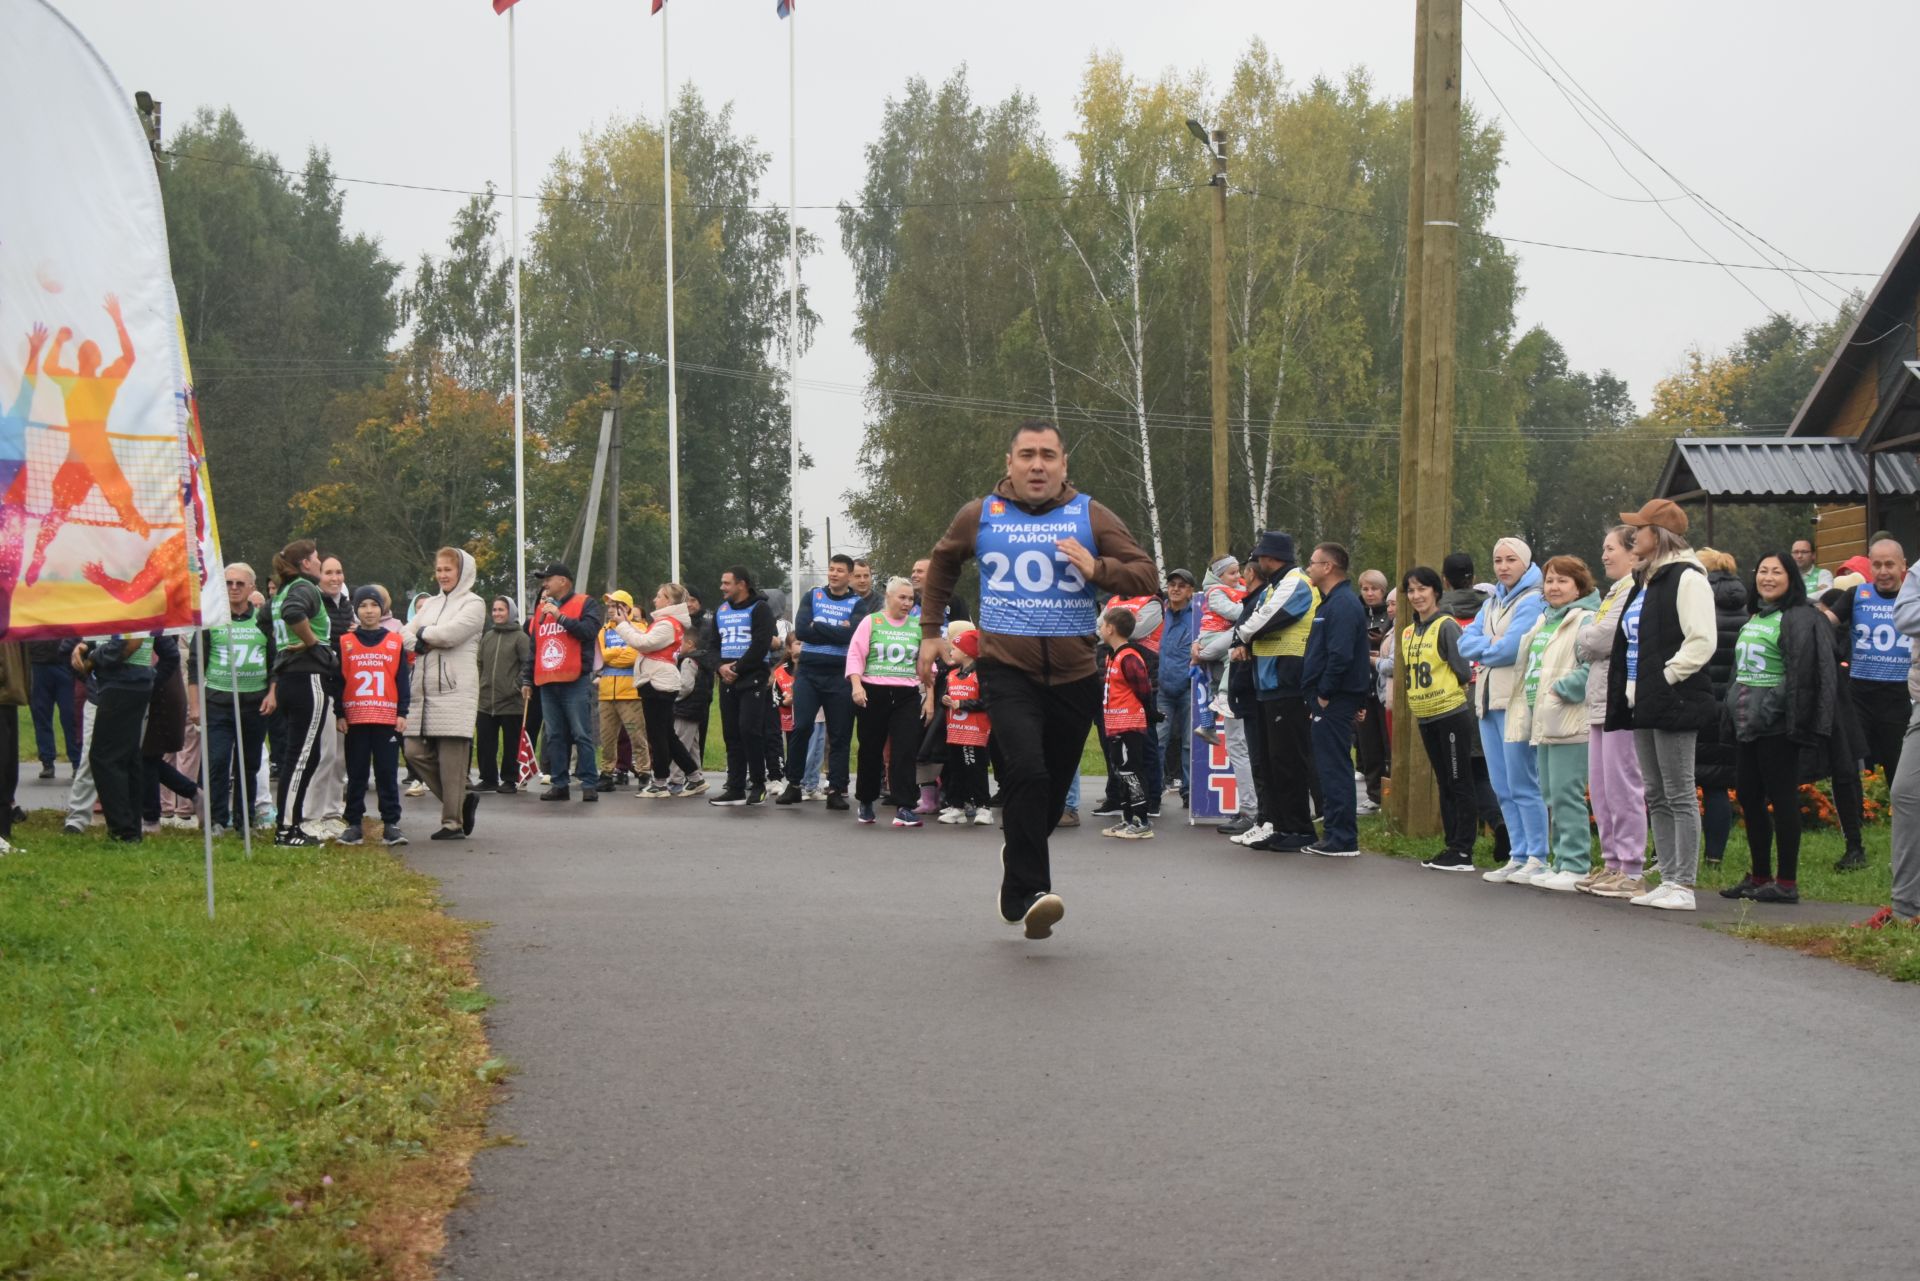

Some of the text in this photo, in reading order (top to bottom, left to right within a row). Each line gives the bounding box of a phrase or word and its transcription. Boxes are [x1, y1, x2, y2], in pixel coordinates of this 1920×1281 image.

[992, 522, 1077, 533] ТУКАЕВСКИЙ
[1008, 532, 1057, 543] РАЙОН
[982, 550, 1085, 592] 203
[1017, 598, 1062, 609] НОРМА
[718, 625, 752, 644] 215
[1855, 623, 1914, 653] 204
[216, 644, 264, 667] 174
[357, 659, 384, 667] РАЙОН
[874, 642, 918, 665] 103
[354, 670, 385, 697] 21
